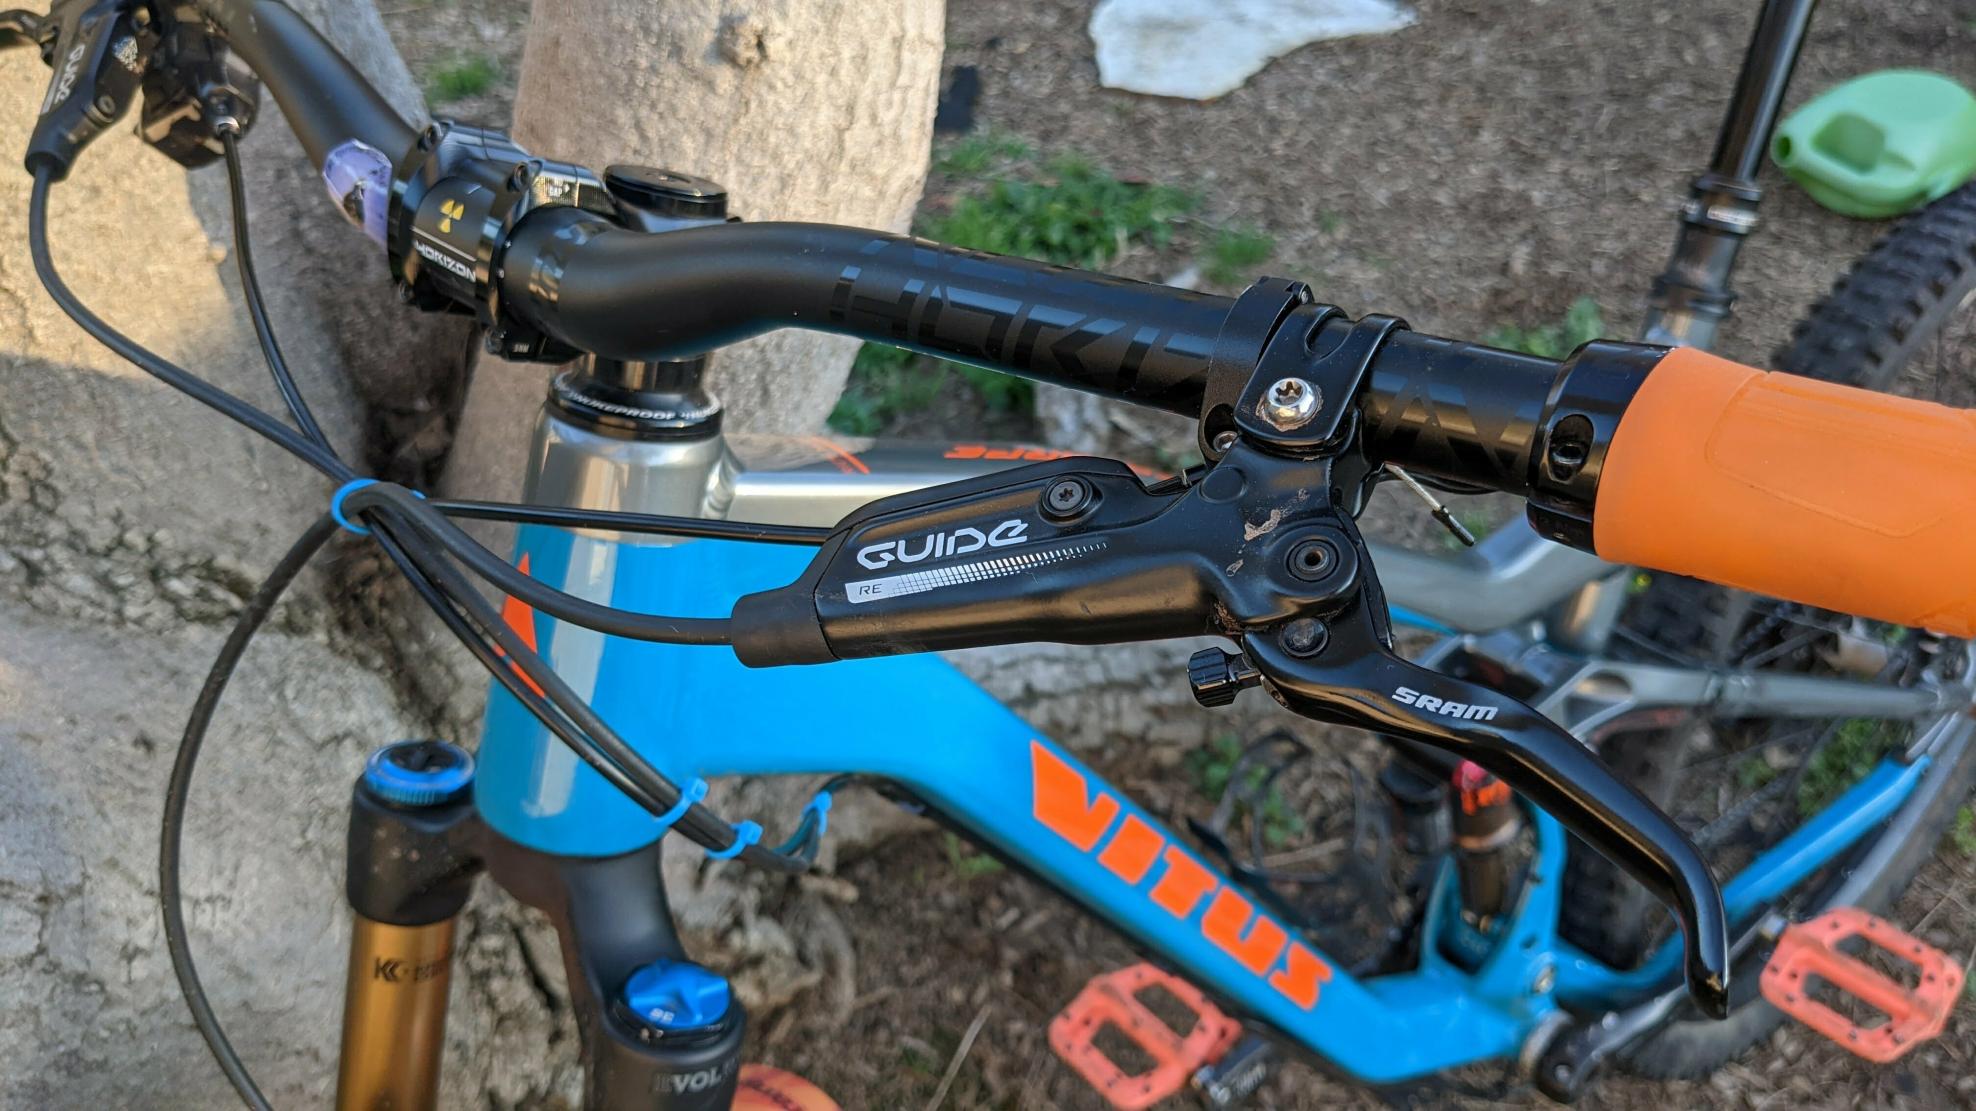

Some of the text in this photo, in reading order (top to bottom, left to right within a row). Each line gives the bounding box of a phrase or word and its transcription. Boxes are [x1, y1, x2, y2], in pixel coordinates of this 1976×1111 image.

[414, 239, 477, 283] HORIZON
[857, 518, 1029, 571] GUIDE
[858, 583, 883, 597] RE
[1391, 686, 1499, 721] SRAM
[1030, 739, 1332, 1011] VITUS
